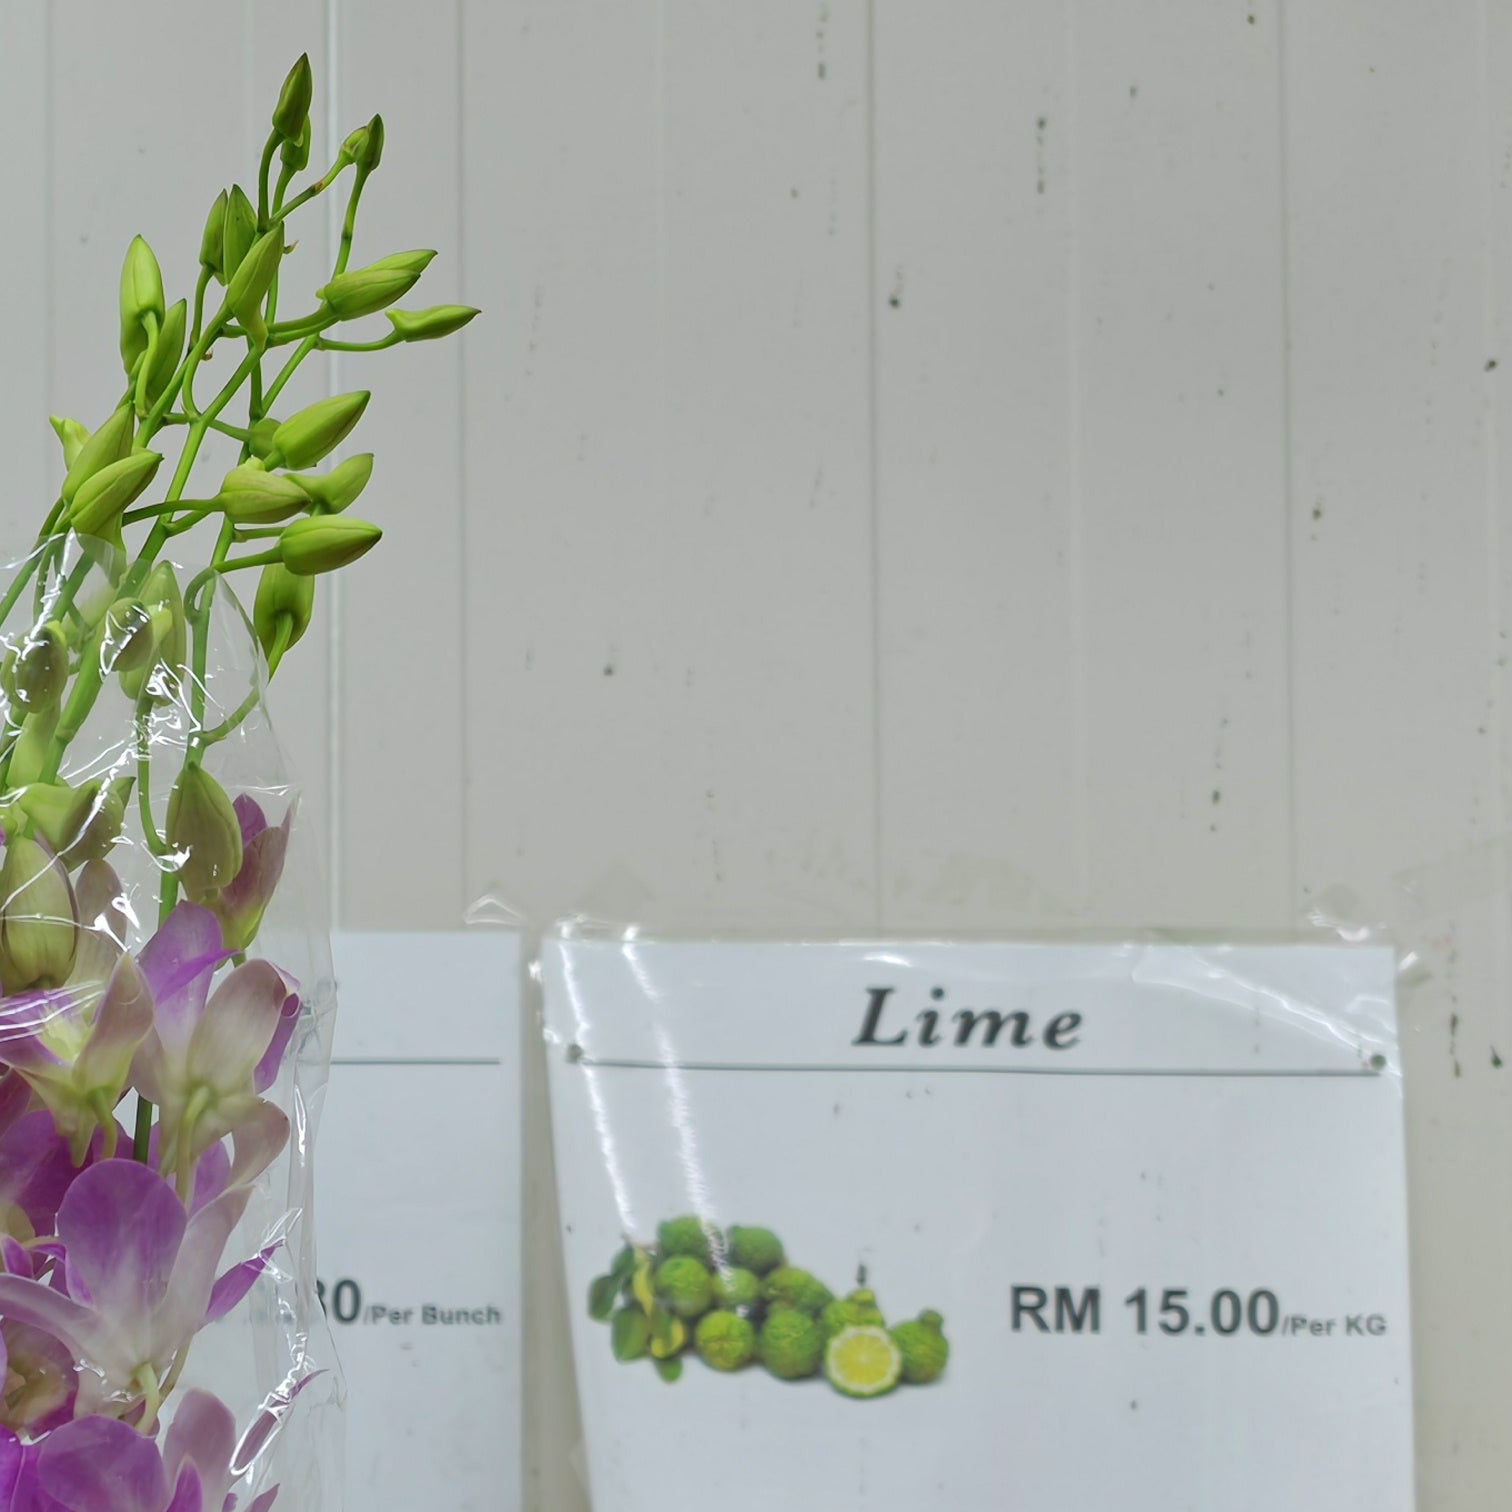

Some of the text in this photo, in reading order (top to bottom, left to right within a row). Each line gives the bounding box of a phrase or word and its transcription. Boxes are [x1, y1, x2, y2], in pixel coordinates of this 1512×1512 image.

[851, 987, 1083, 1050] Lime
[422, 1304, 501, 1325] Bunch
[1010, 1284, 1101, 1334] RM
[1345, 1314, 1387, 1336] KG
